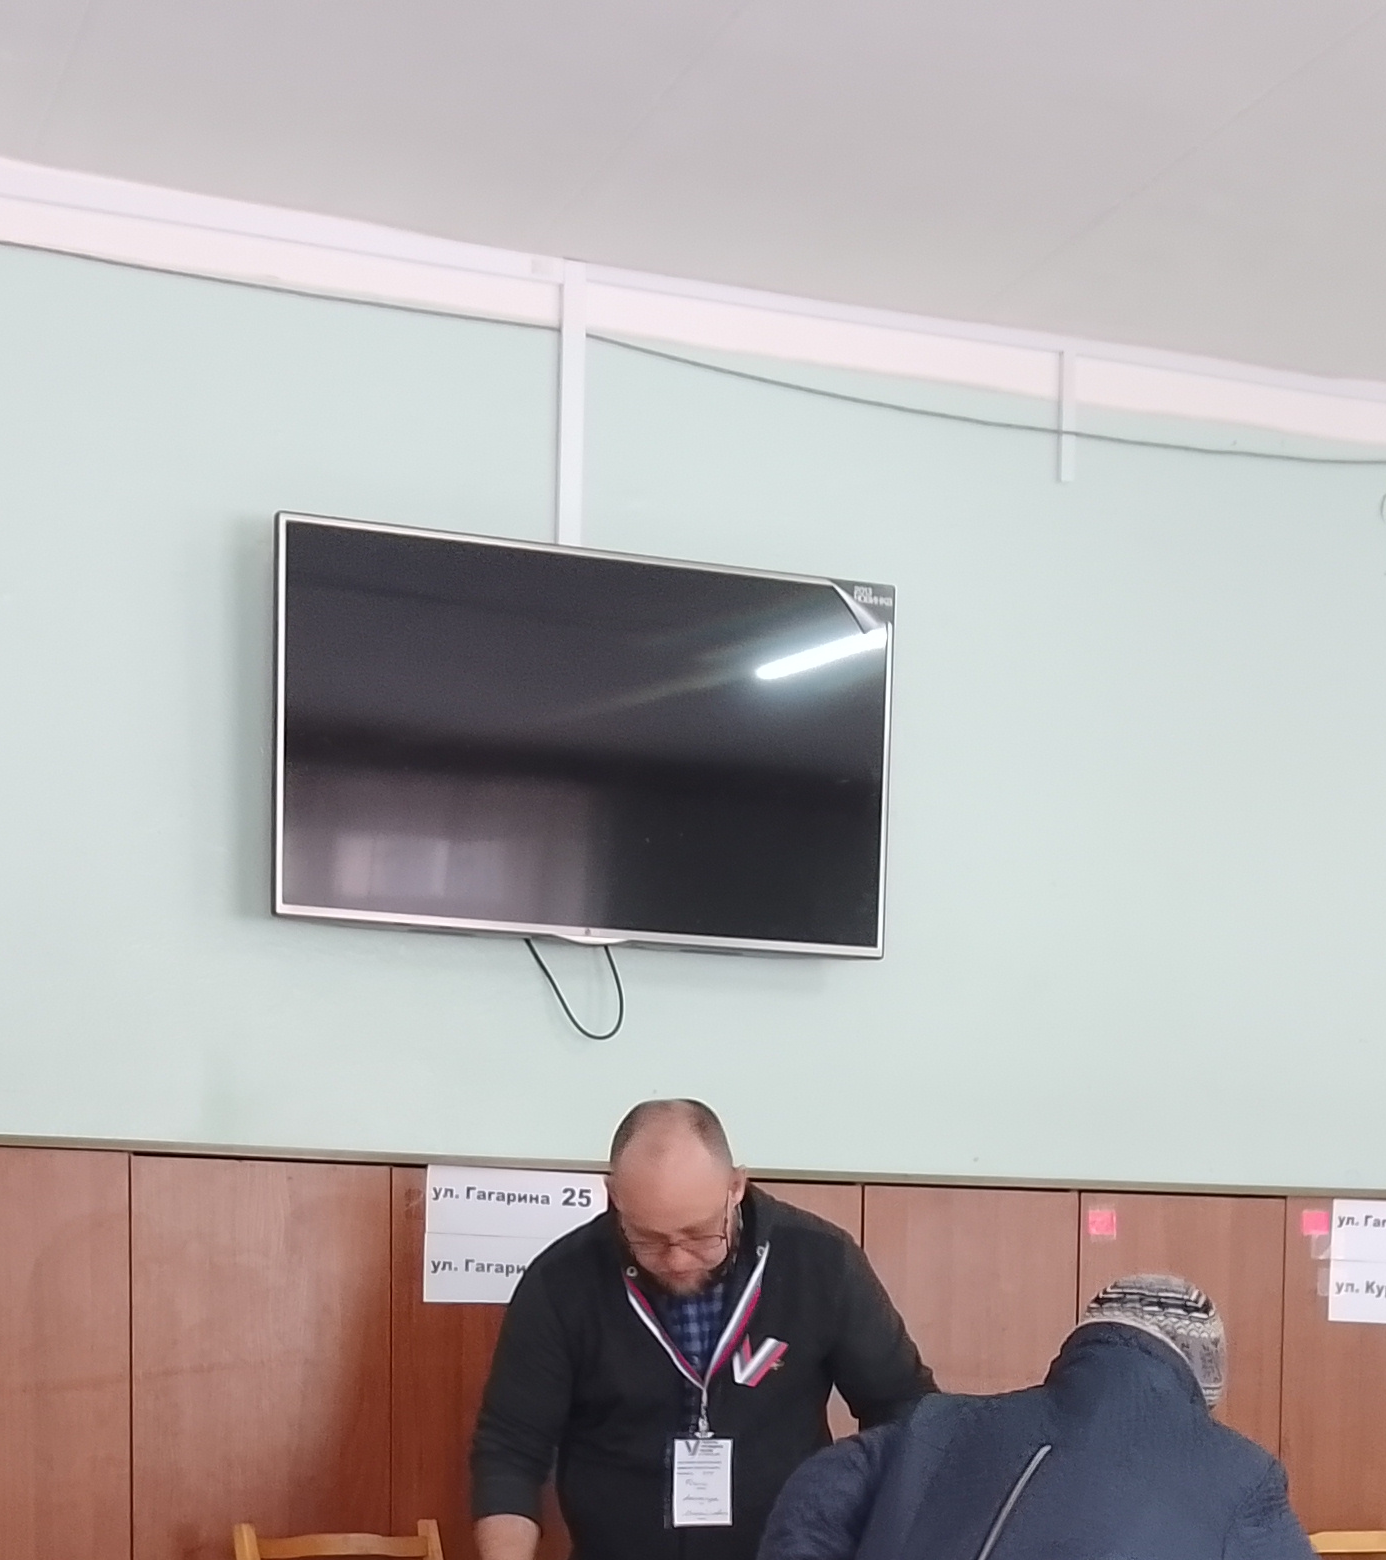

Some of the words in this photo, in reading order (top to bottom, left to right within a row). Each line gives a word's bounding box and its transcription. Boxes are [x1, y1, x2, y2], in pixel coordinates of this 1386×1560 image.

[432, 1186, 459, 1201] ул.
[466, 1186, 551, 1206] Гагарина
[562, 1187, 592, 1208] 25
[1337, 1215, 1359, 1228] ул.
[430, 1259, 458, 1274] ул.
[465, 1258, 527, 1277] Гагари
[1335, 1281, 1359, 1295] ул.
